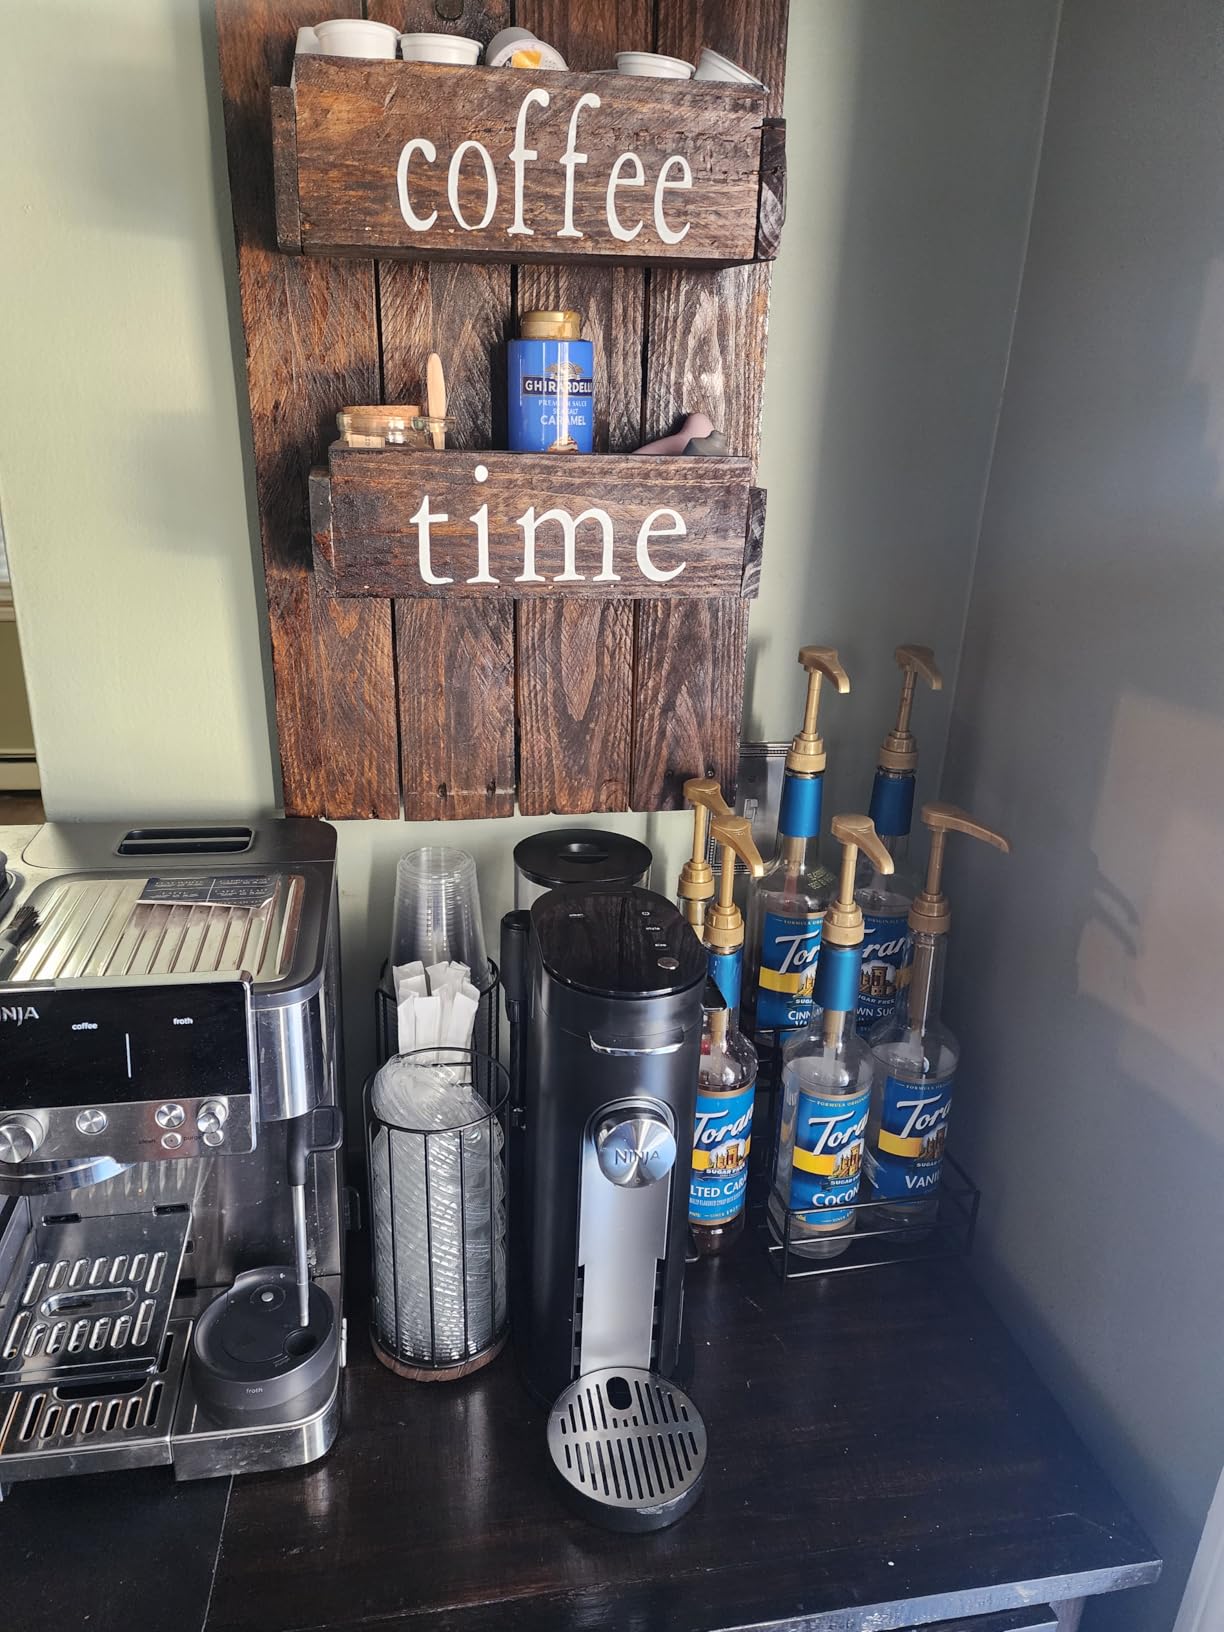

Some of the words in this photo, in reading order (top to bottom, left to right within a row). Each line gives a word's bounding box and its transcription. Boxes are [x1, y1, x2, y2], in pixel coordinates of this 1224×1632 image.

[397, 88, 693, 245] coffee
[409, 465, 687, 585] time
[71, 1022, 98, 1031] coffee
[173, 1017, 194, 1025] froth
[614, 1148, 661, 1166] NINJA
[246, 1387, 263, 1395] froth
